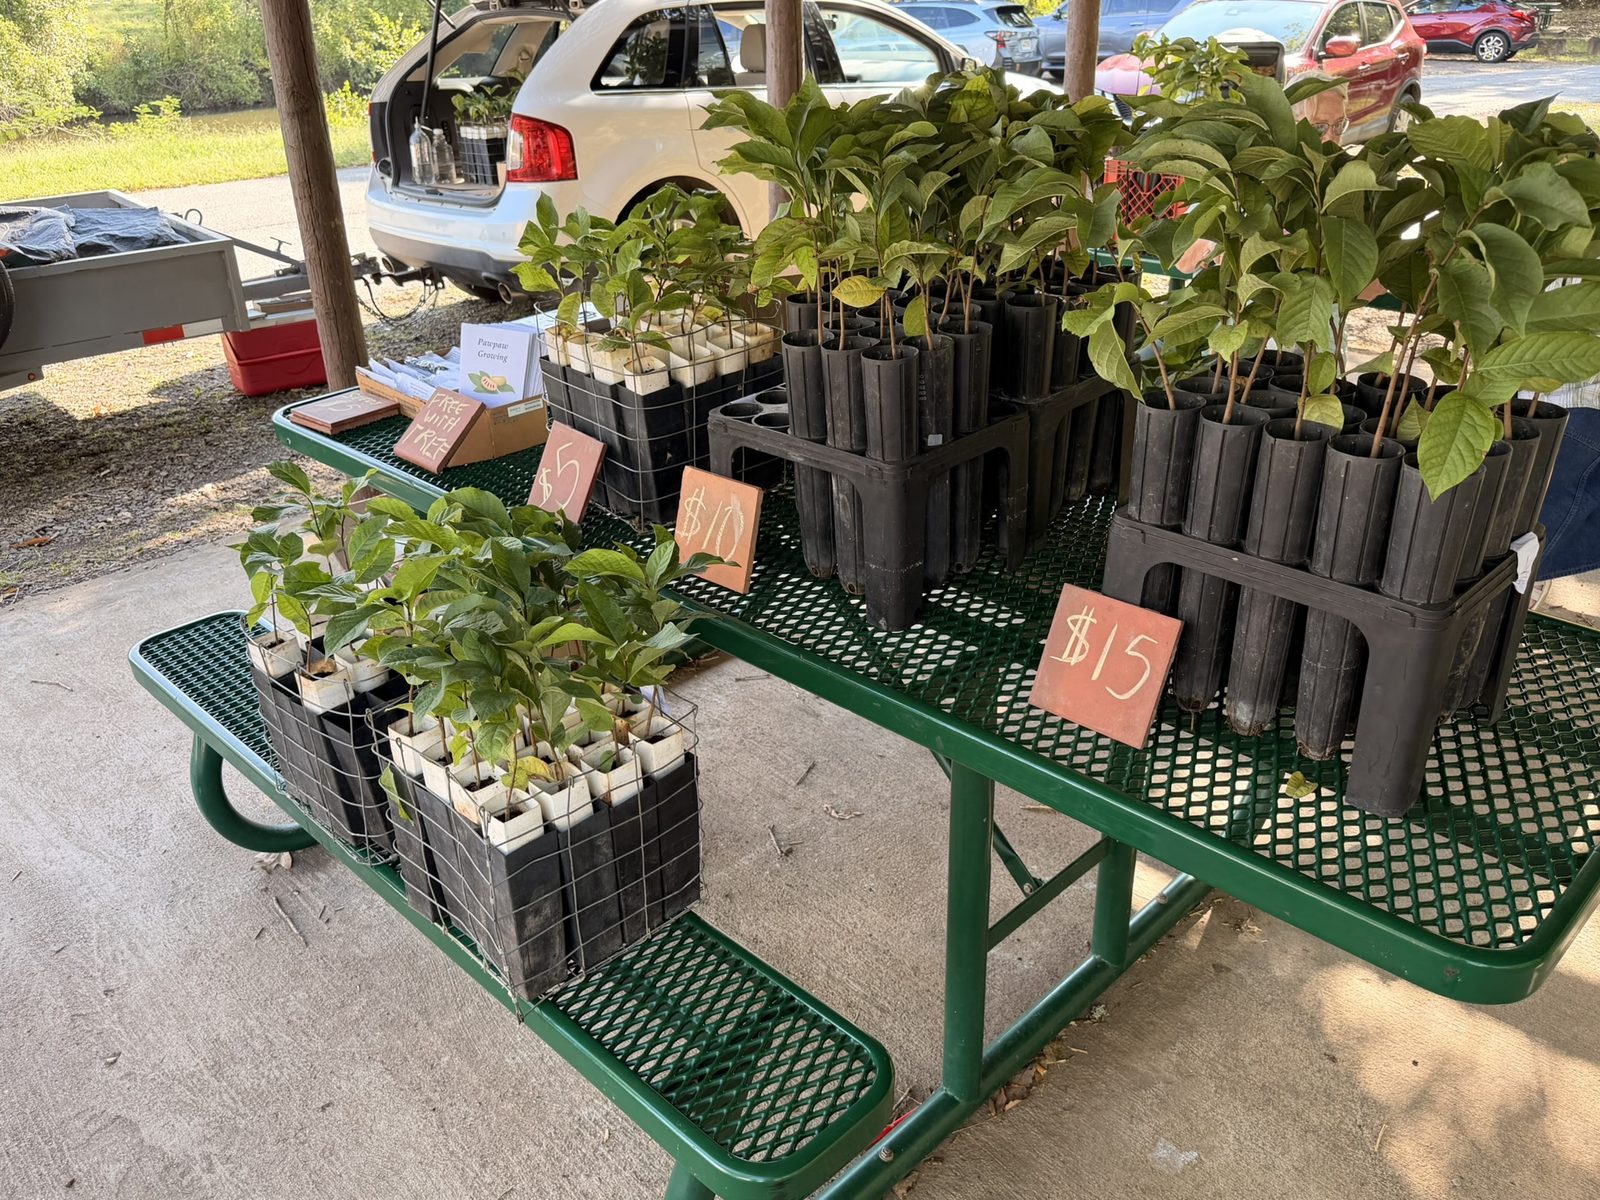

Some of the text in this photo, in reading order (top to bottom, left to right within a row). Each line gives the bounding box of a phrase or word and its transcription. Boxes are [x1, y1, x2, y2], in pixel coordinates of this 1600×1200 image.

[477, 338, 509, 350] Pawpaw
[477, 350, 508, 363] Growing
[427, 392, 470, 415] FREE
[424, 410, 461, 433] WITH
[402, 423, 451, 460] TREE
[538, 441, 580, 510] $5
[675, 485, 745, 563] $10
[1050, 605, 1159, 700] $15
